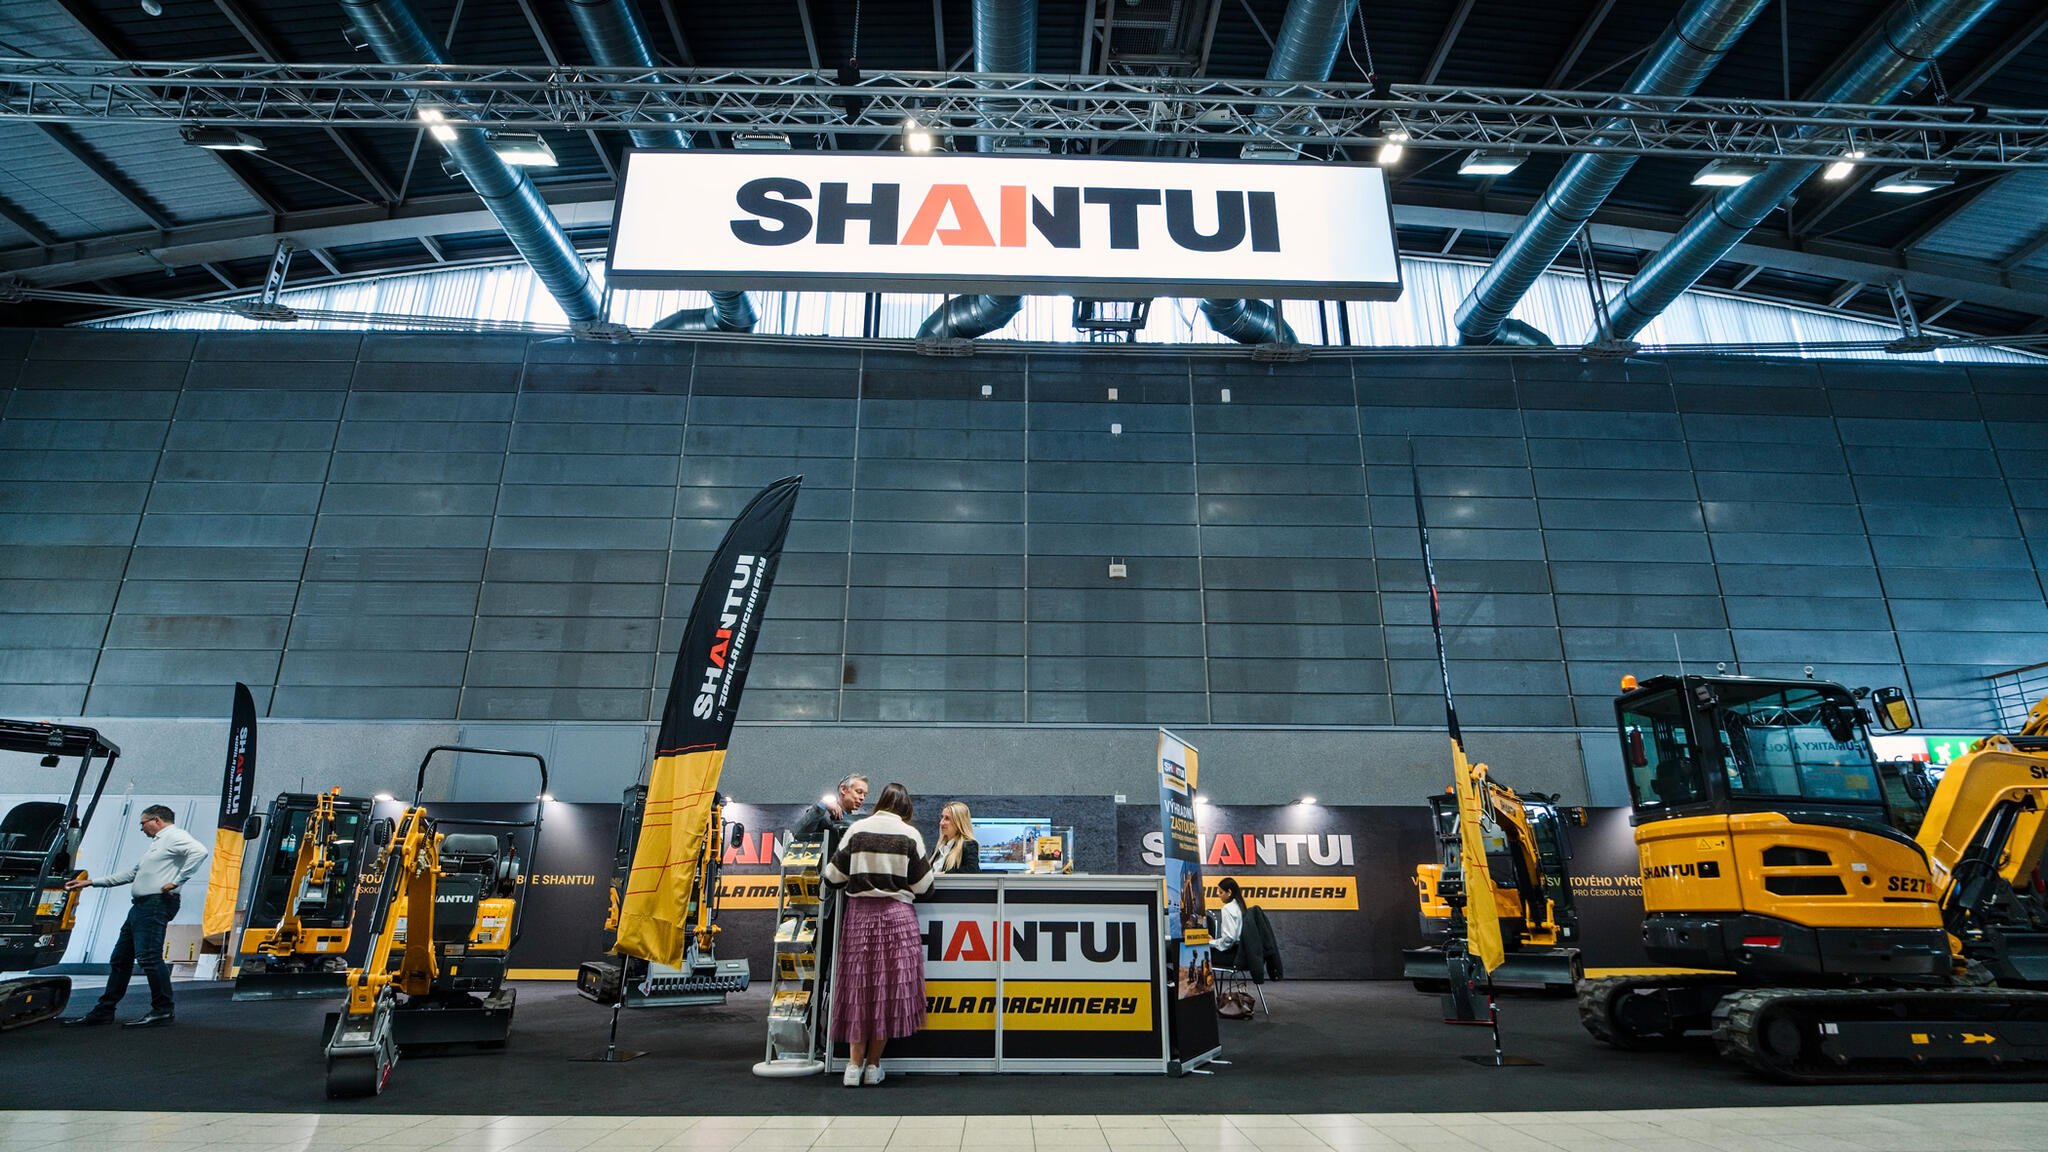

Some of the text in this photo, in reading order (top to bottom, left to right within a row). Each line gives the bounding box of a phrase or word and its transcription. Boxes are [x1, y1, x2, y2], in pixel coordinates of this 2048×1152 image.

[730, 176, 1281, 253] SHANTUI
[692, 554, 755, 721] SHANTUI
[716, 710, 724, 722] BY
[734, 556, 767, 650] MACHINERY
[231, 727, 248, 814] SHANTUI
[541, 874, 595, 886] SHANTUI
[1644, 863, 1696, 880] SHANTUI
[1240, 886, 1347, 899] MACHINERY
[1590, 887, 1620, 897] ČESKOU
[921, 920, 1137, 963] HANTUI
[978, 996, 1138, 1015] MACHINERY
